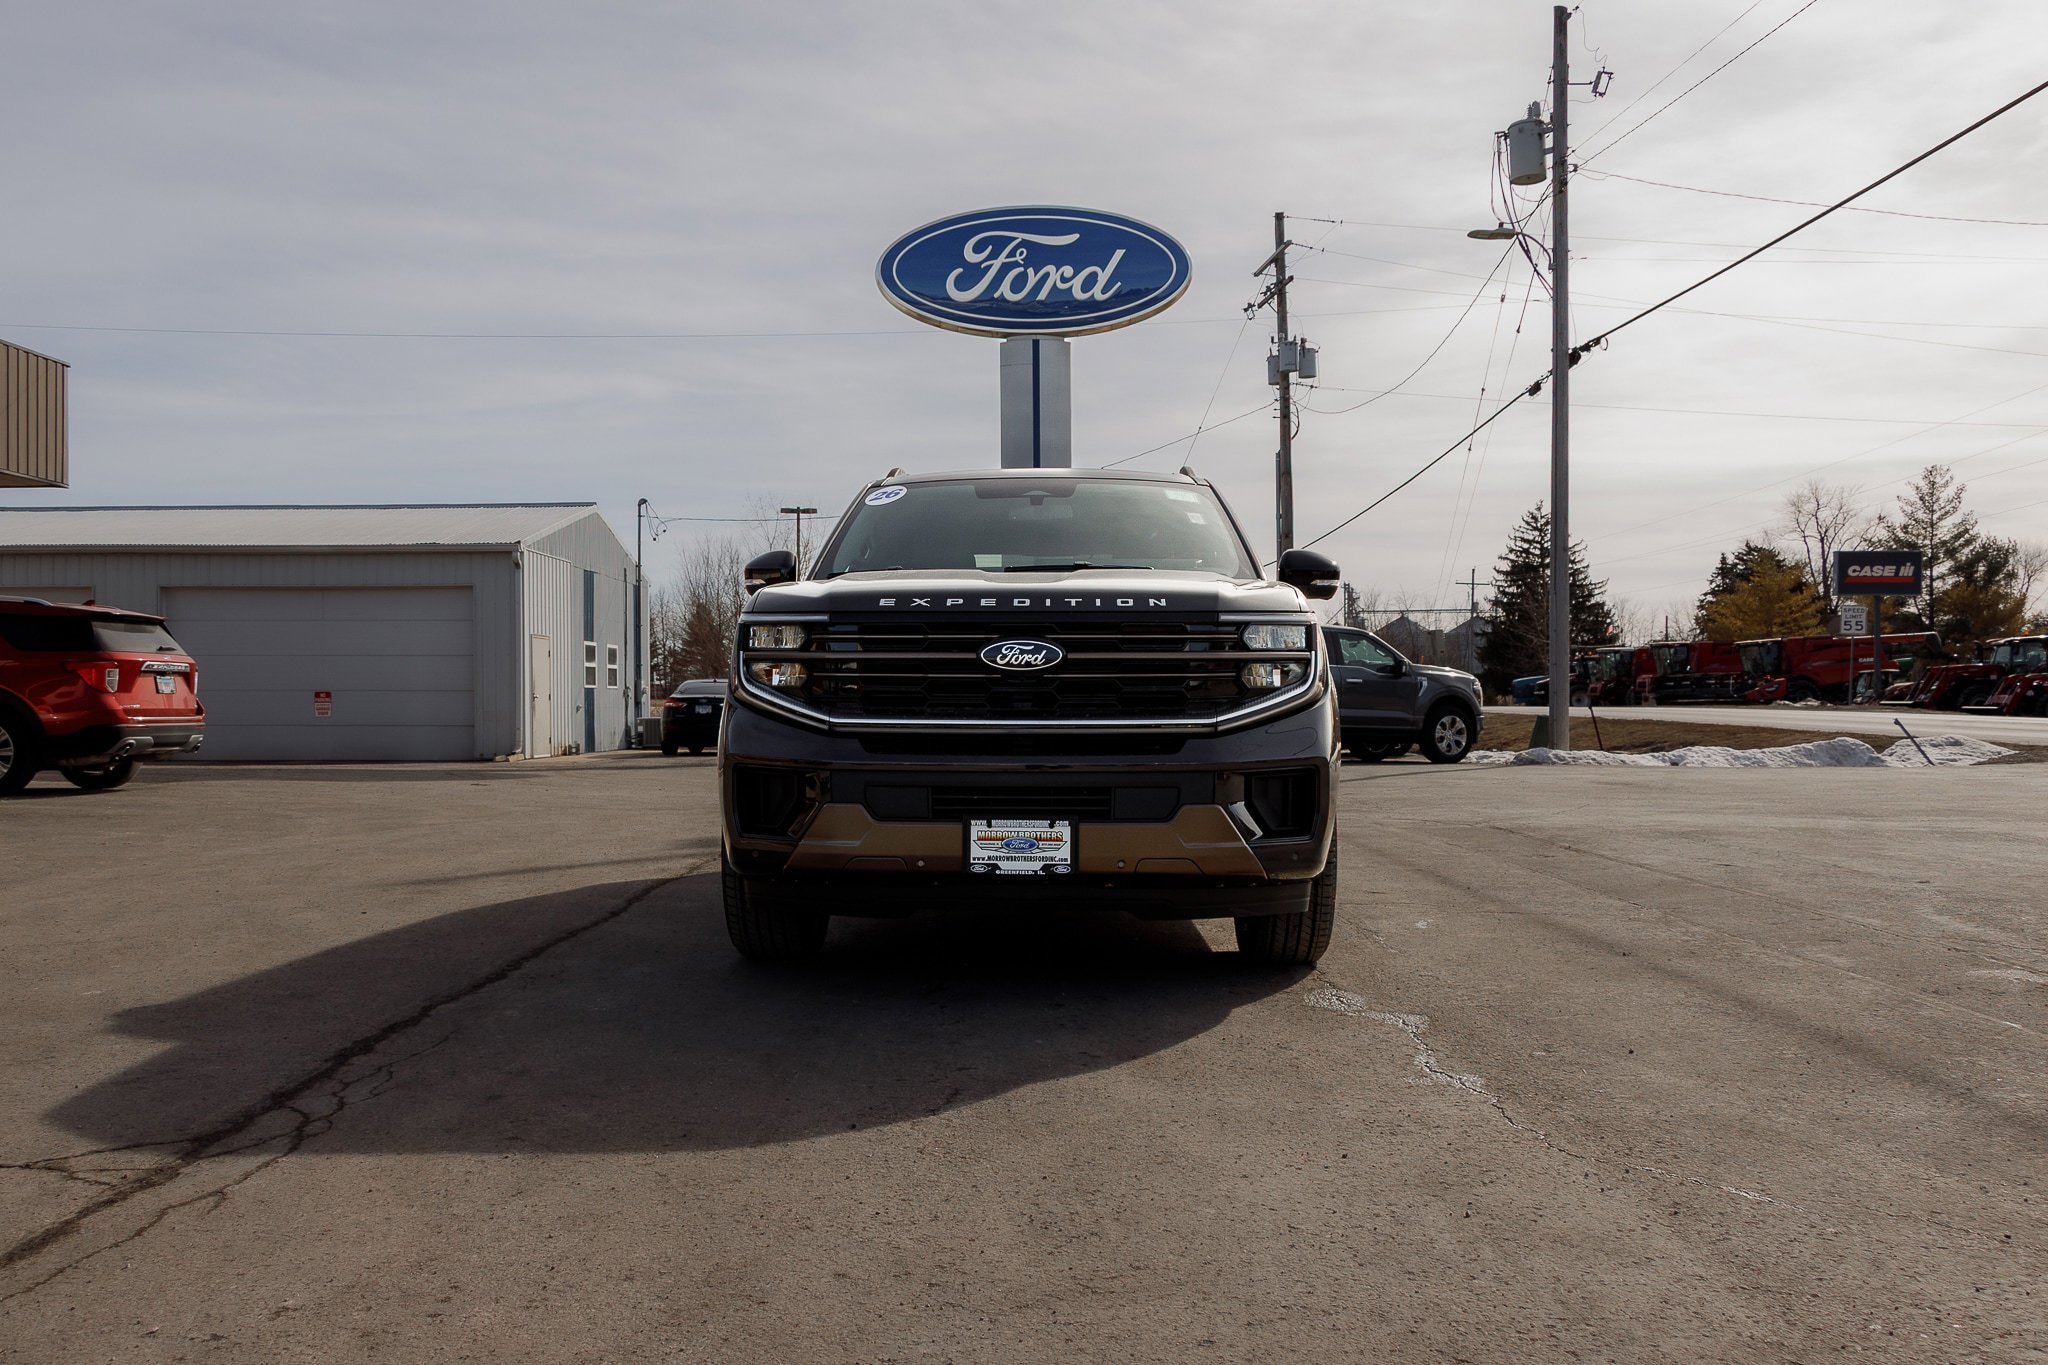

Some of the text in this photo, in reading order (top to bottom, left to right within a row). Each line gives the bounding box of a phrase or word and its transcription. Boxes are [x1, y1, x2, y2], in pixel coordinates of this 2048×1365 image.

[945, 230, 1127, 302] Ford
[868, 488, 904, 502] 26
[1847, 565, 1896, 576] CASE
[878, 597, 1168, 608] EXPEDITION
[1843, 620, 1864, 632] 55
[996, 644, 1047, 666] Ford
[977, 830, 1064, 842] MORROW BROTHERS
[1009, 840, 1030, 849] Ford
